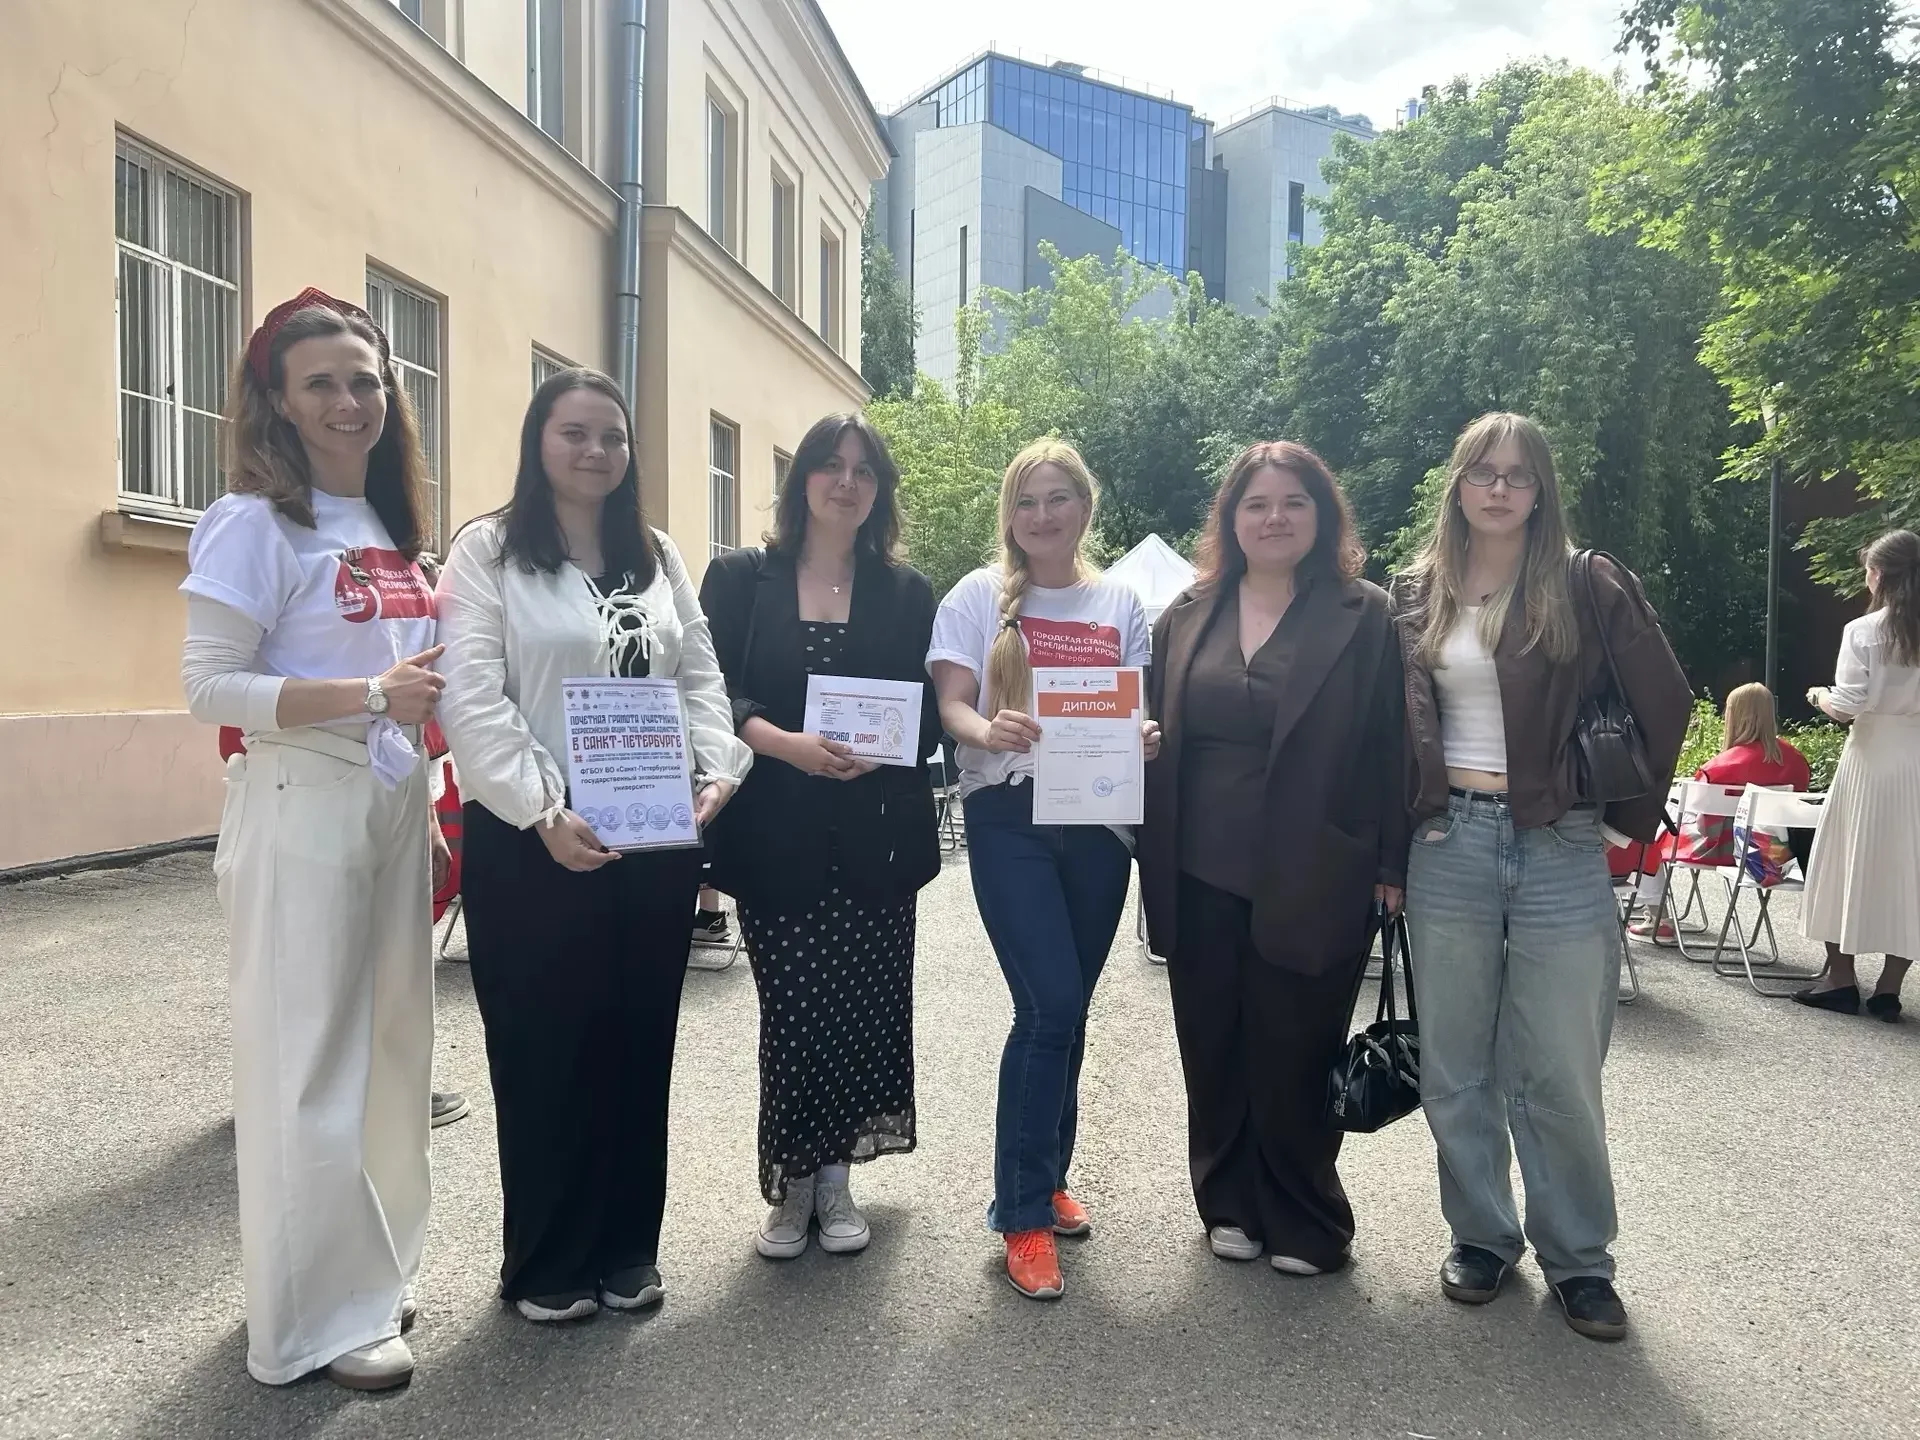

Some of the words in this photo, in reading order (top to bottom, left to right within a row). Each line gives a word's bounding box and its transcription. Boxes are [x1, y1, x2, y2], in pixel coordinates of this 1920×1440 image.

[1032, 630, 1081, 644] ГОРОДСКАЯ
[1083, 637, 1120, 651] СТАНЦИЯ
[1033, 638, 1092, 653] ПЕРЕЛИВАНИЯ
[1094, 646, 1120, 660] КРОВИ
[1033, 647, 1095, 663] Санкт-Петербург
[1061, 701, 1117, 713] ДИПЛОМ
[608, 714, 639, 724] ГРАМОТА
[640, 714, 679, 725] УЧАСТНИКУ
[572, 737, 579, 751] В
[583, 734, 682, 750] САНКТ-ПЕТЕРБУРГЕ
[853, 732, 880, 744] ДОНОР!
[580, 767, 603, 775] ФГБОУ
[616, 764, 681, 773] «Санкт-Петербургский
[580, 775, 637, 784] государственный
[638, 773, 682, 781] экономический
[613, 783, 656, 792] университет»
